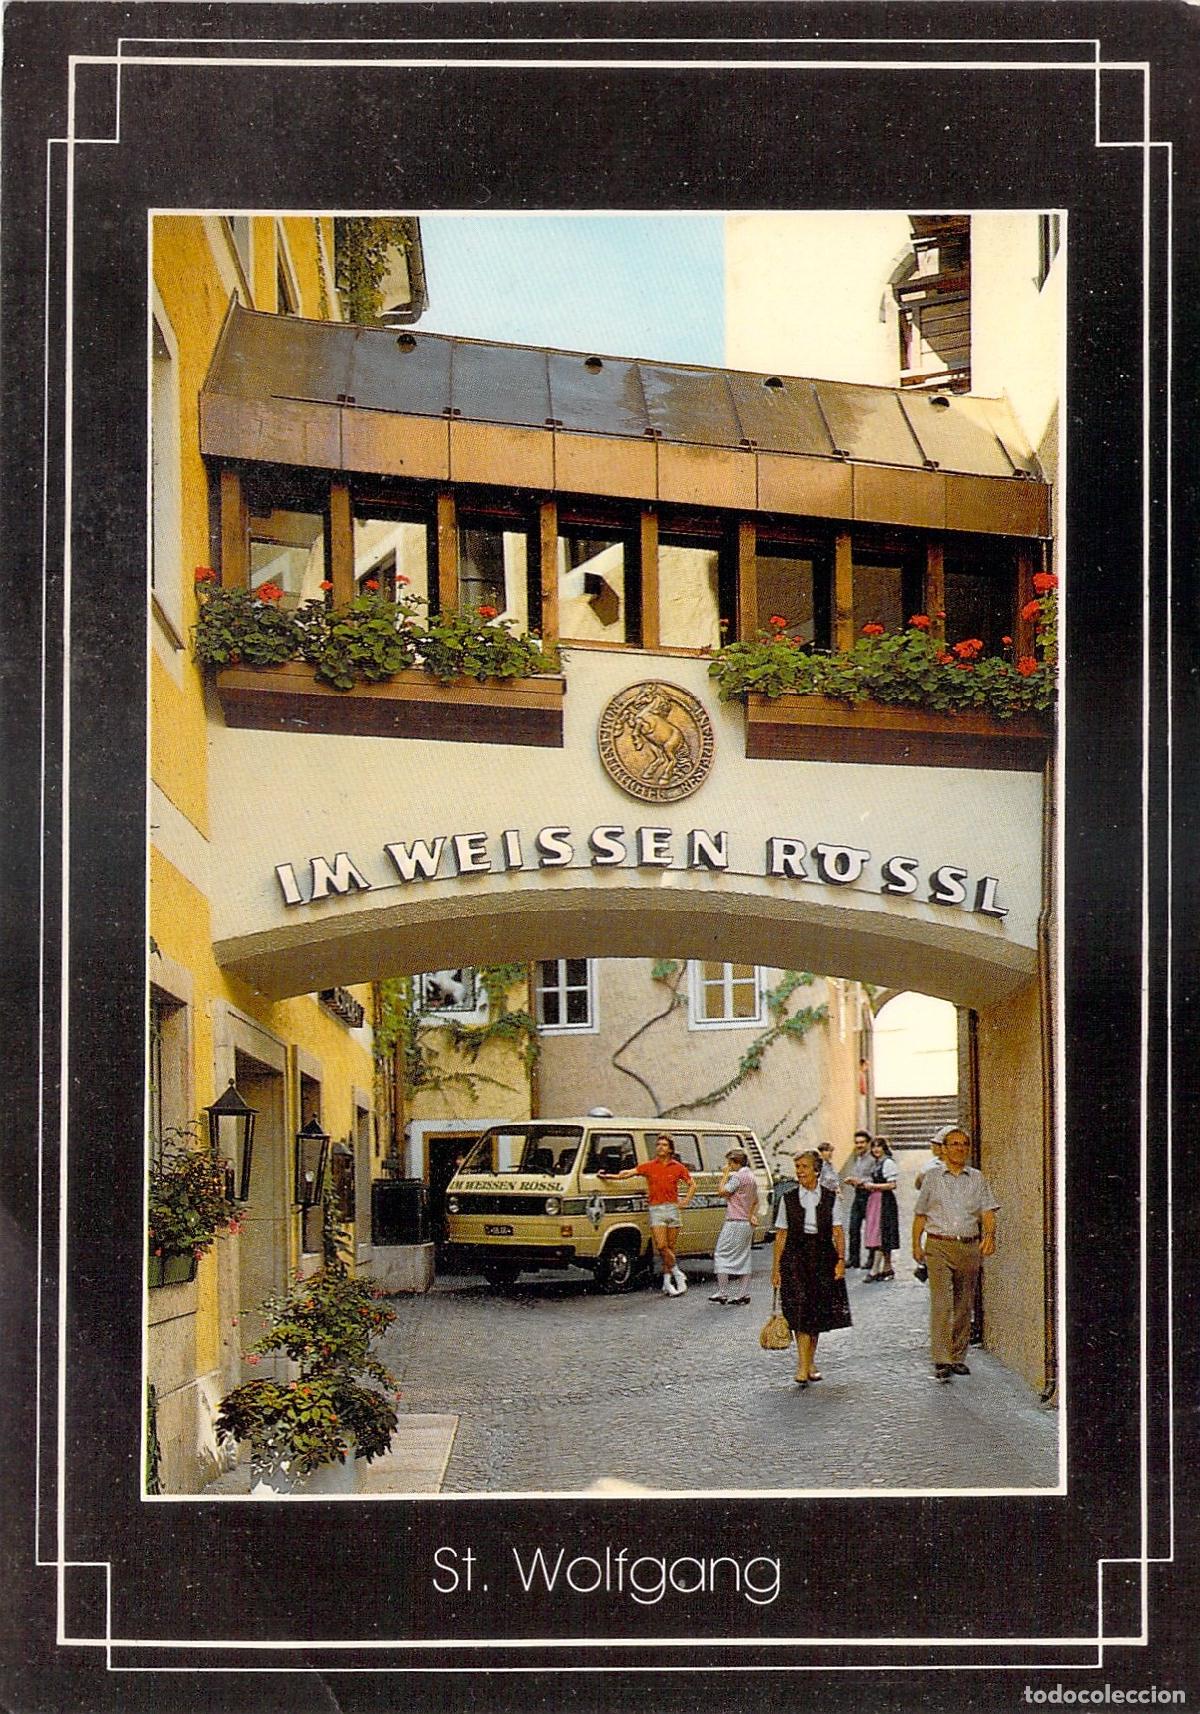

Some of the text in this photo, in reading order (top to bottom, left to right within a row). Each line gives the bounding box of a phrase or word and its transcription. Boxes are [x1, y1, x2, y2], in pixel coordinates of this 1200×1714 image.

[275, 852, 371, 907] IM
[383, 825, 730, 882] WEISSEN
[465, 1180, 517, 1191] WEISSEN
